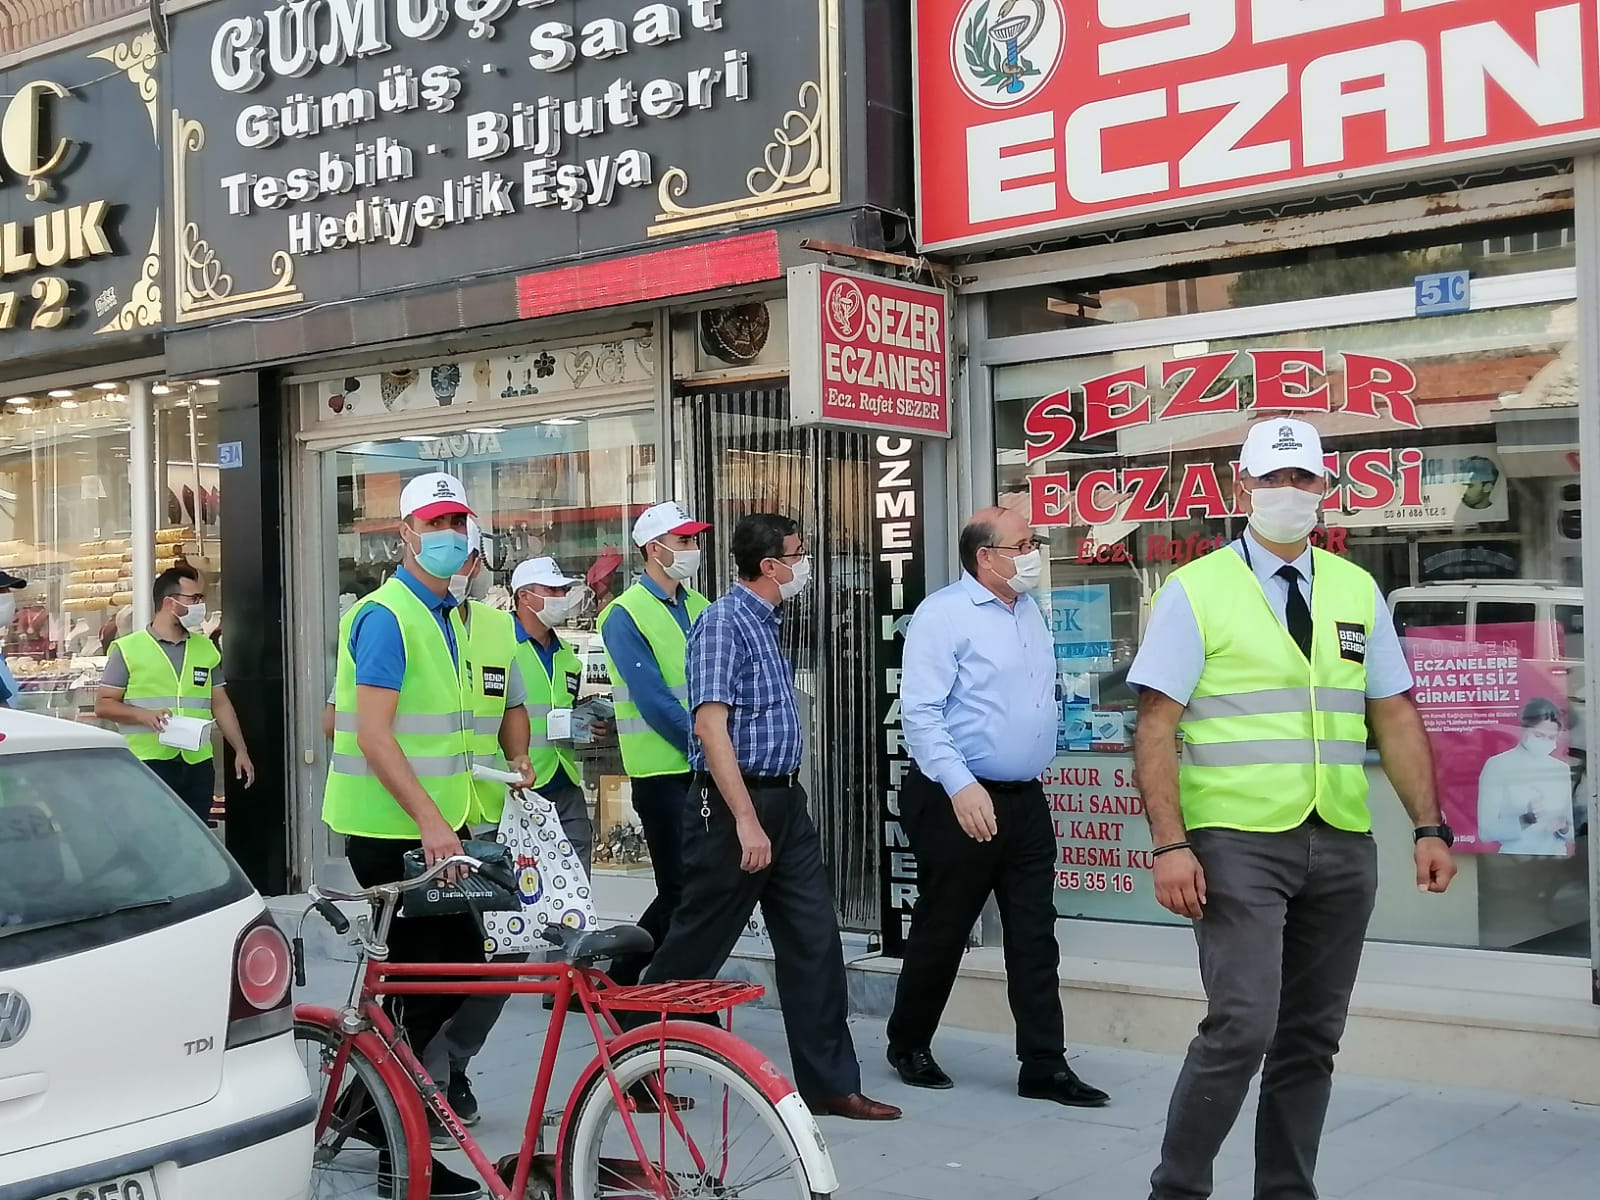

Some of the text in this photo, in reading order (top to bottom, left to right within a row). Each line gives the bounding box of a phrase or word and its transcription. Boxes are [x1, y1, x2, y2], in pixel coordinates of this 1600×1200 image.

[235, 65, 462, 148] Gümüş
[966, 3, 1600, 224] ECZAN
[0, 79, 72, 202] Ç
[220, 49, 749, 217] Tesbih Bijuteri
[288, 148, 653, 256] Hediyelik Eşya
[0, 200, 114, 274] LUK
[866, 294, 941, 353] SEZER
[828, 388, 940, 420] Ecz. Rafet SEZER
[1023, 347, 1424, 466] SEZER
[1076, 536, 1135, 565] Ecz.
[1414, 657, 1518, 671] ECZANELERE
[1416, 669, 1518, 687] MASKESİZ
[1415, 687, 1510, 703] GİRMEYİNİZ
[1070, 820, 1124, 841] KART
[1127, 849, 1156, 870] KU
[1084, 872, 1106, 891] 35
[1112, 873, 1134, 892] 16
[184, 1036, 214, 1056] TDI
